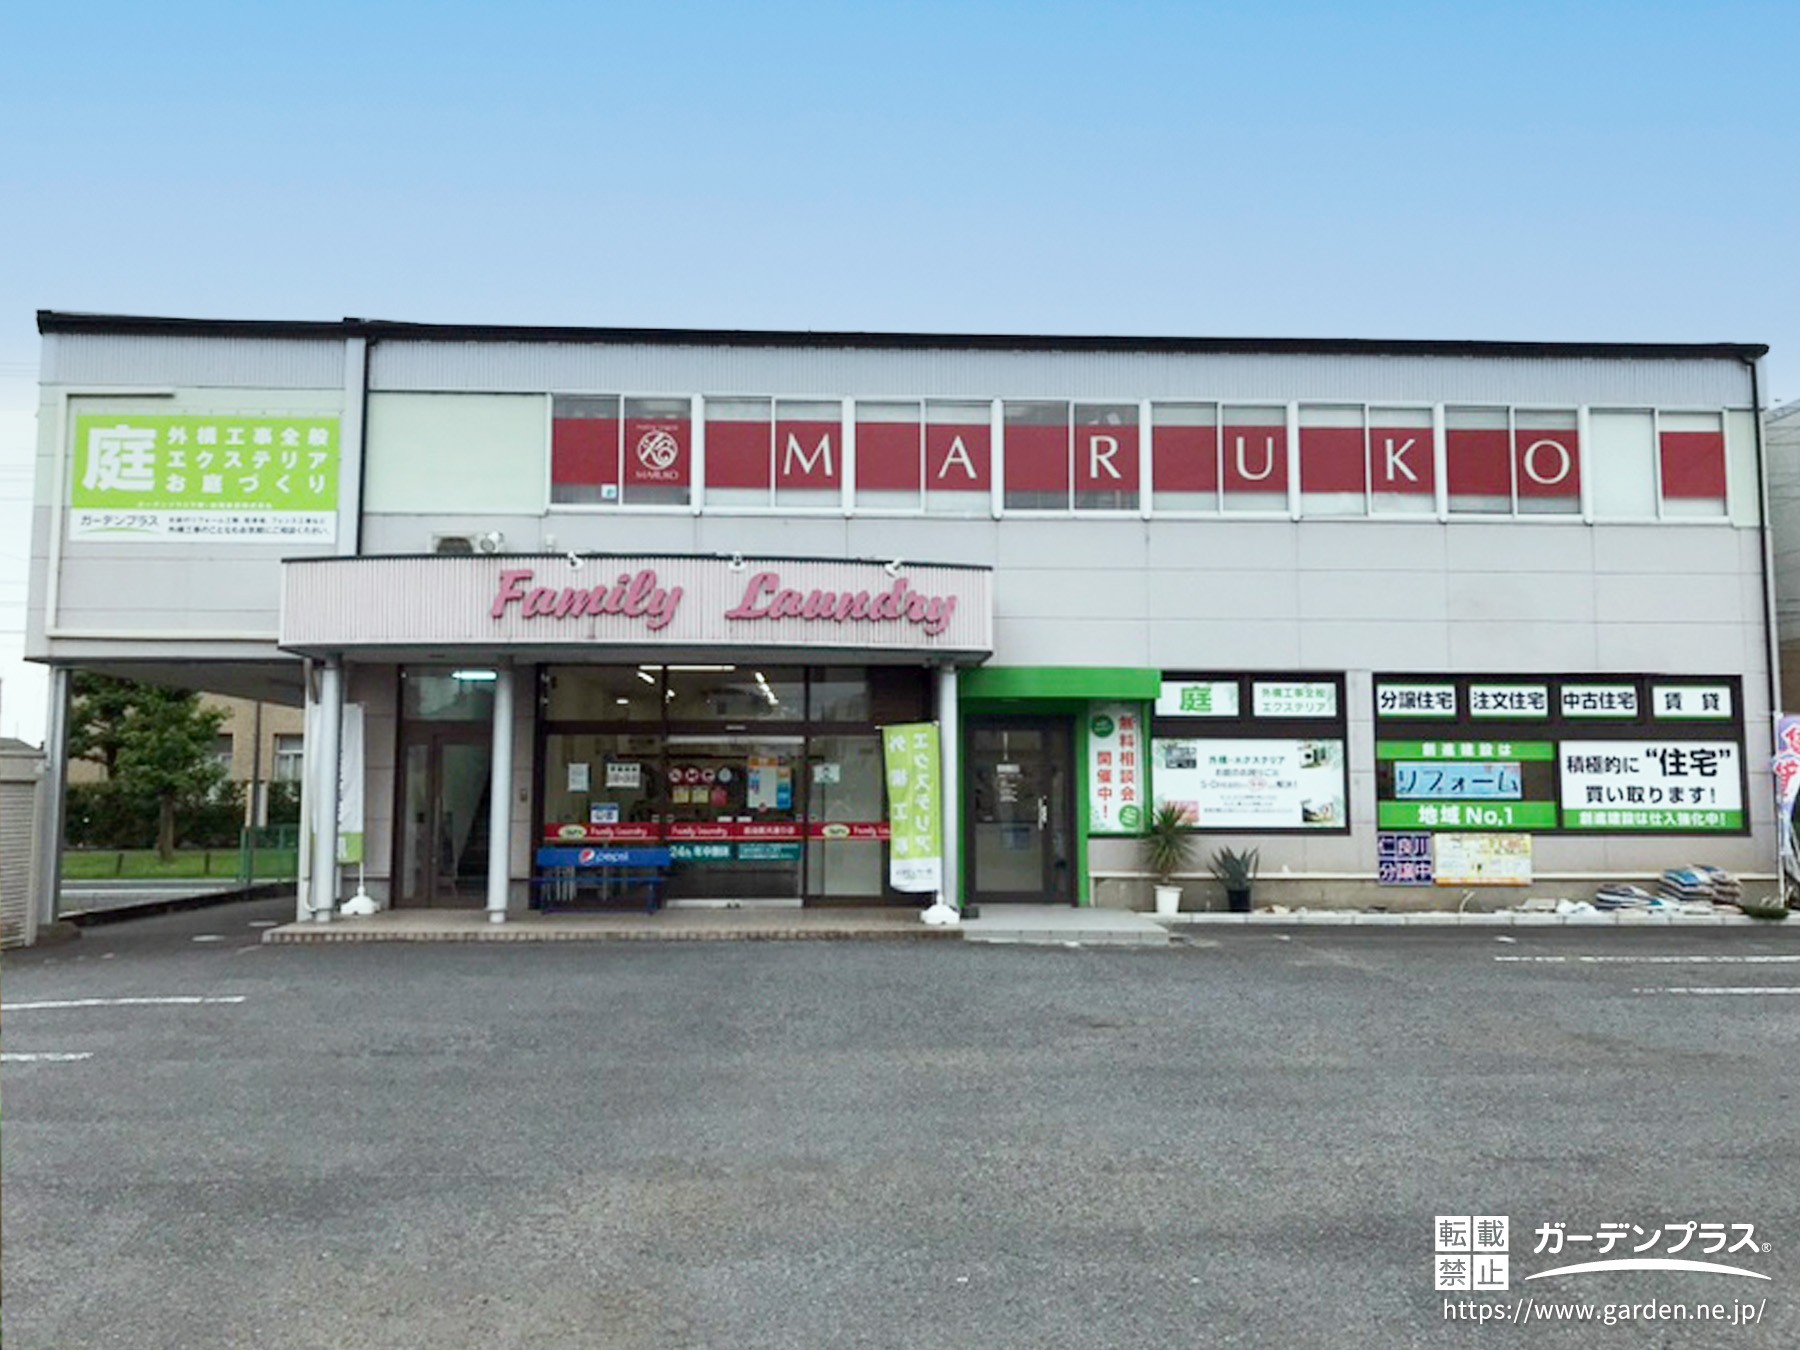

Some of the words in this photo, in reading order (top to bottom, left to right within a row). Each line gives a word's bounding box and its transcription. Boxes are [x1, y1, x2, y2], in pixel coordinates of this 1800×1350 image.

[167, 426, 329, 446] 外構工事全般
[83, 424, 157, 492] 庭
[166, 450, 329, 470] エクステリア
[166, 473, 326, 494] お庭づくり
[81, 514, 159, 527] ガーデンプラス
[490, 569, 684, 631] Family
[723, 572, 959, 636] Laundry
[1179, 686, 1212, 712] 庭
[1262, 702, 1326, 713] エクステリア
[1380, 691, 1453, 710] 分譲住宅
[1473, 691, 1546, 711] 注文住宅
[1563, 691, 1636, 711] 中古住宅
[1120, 716, 1135, 801] 無料相談会
[1398, 770, 1519, 793] リフォーム
[1586, 785, 1716, 804] 買い取ります!
[596, 851, 629, 862] pepsi
[1379, 860, 1431, 882] 分譲中
